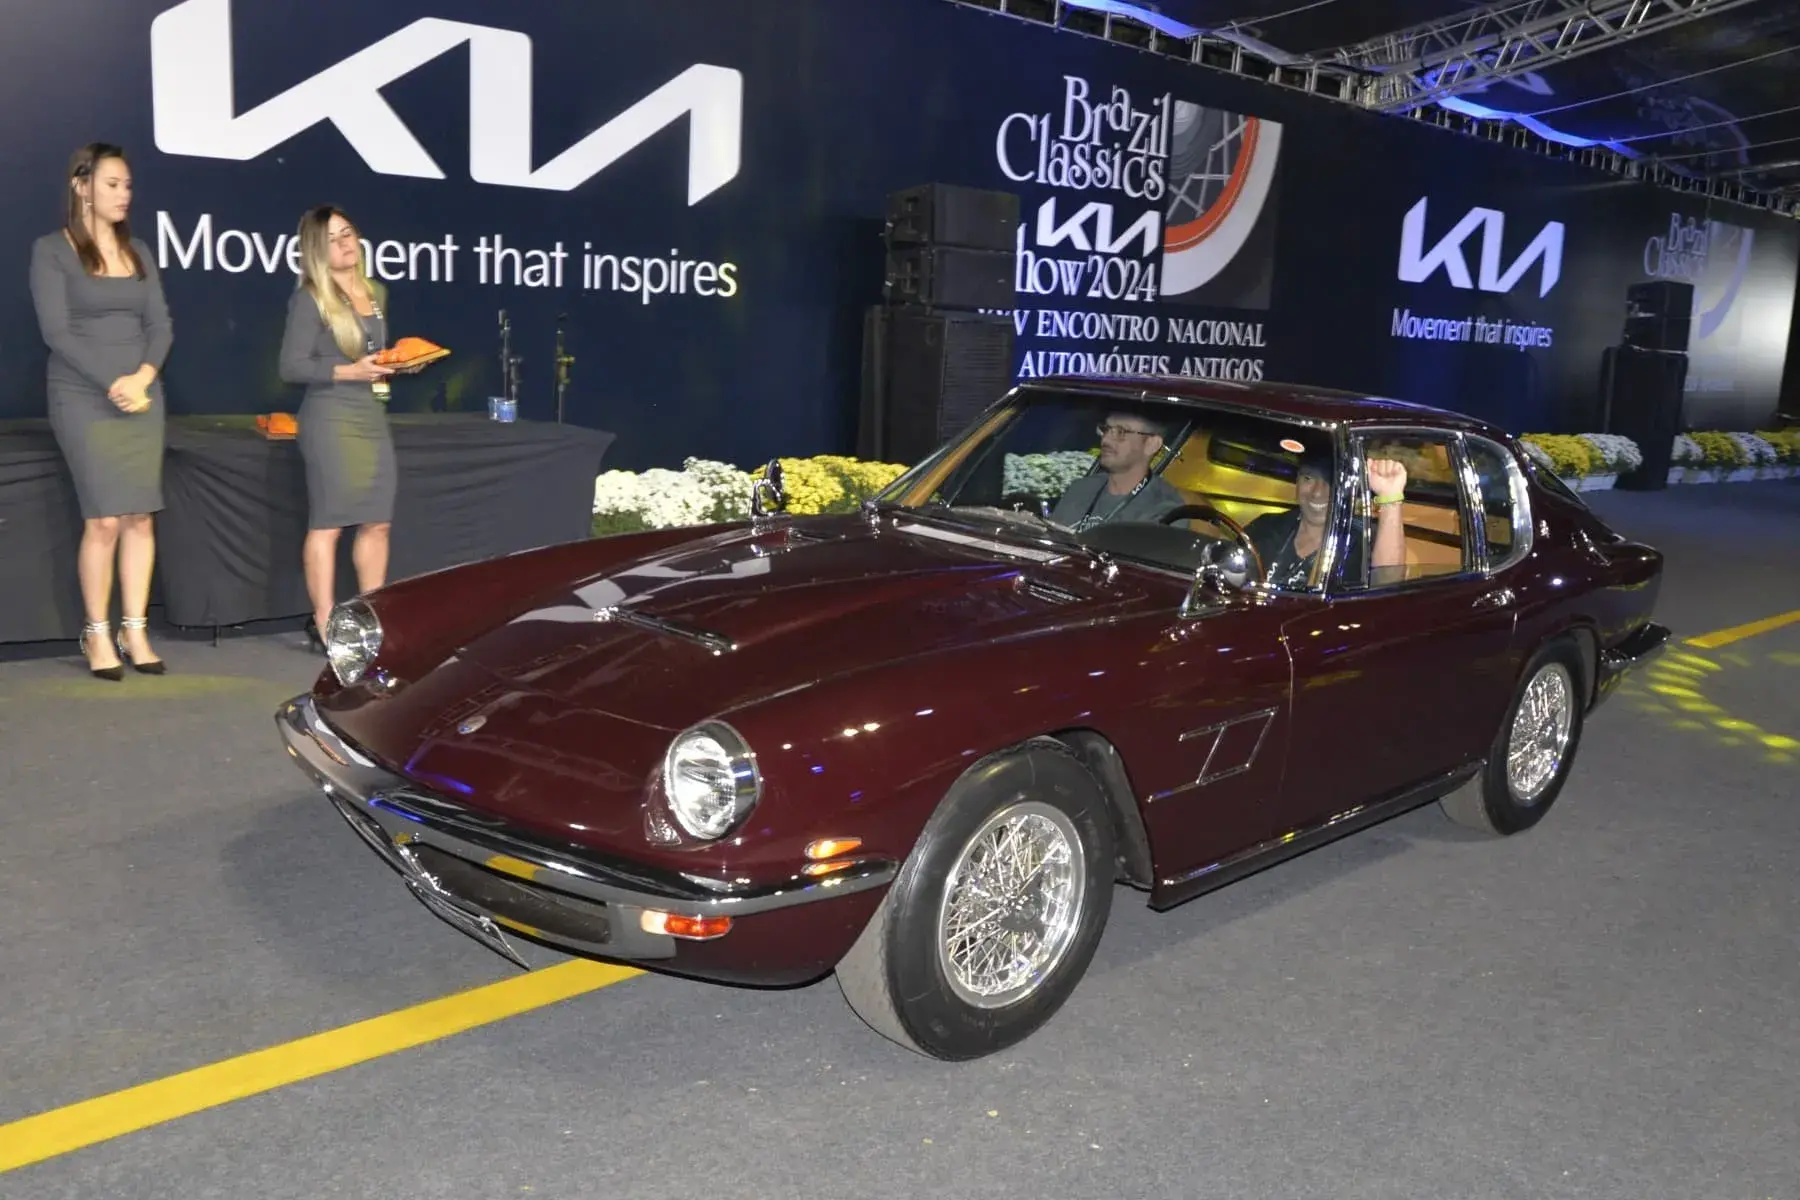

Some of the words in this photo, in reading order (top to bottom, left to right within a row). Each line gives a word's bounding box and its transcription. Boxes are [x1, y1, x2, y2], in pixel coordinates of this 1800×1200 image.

[1060, 75, 1171, 158] Brazil
[996, 112, 1166, 201] Classics
[1036, 196, 1161, 258] KIA
[1398, 196, 1565, 298] KIA
[473, 234, 569, 288] that
[583, 241, 738, 305] inspires
[1035, 308, 1160, 342] ENCONTRO
[1167, 317, 1267, 347] NACIONAL
[1391, 308, 1472, 342] Movement
[1474, 316, 1503, 344] that
[1504, 319, 1553, 352] inspires
[1018, 346, 1170, 378] AUTOMÓVEIS
[1180, 356, 1265, 382] ANTIGOS
